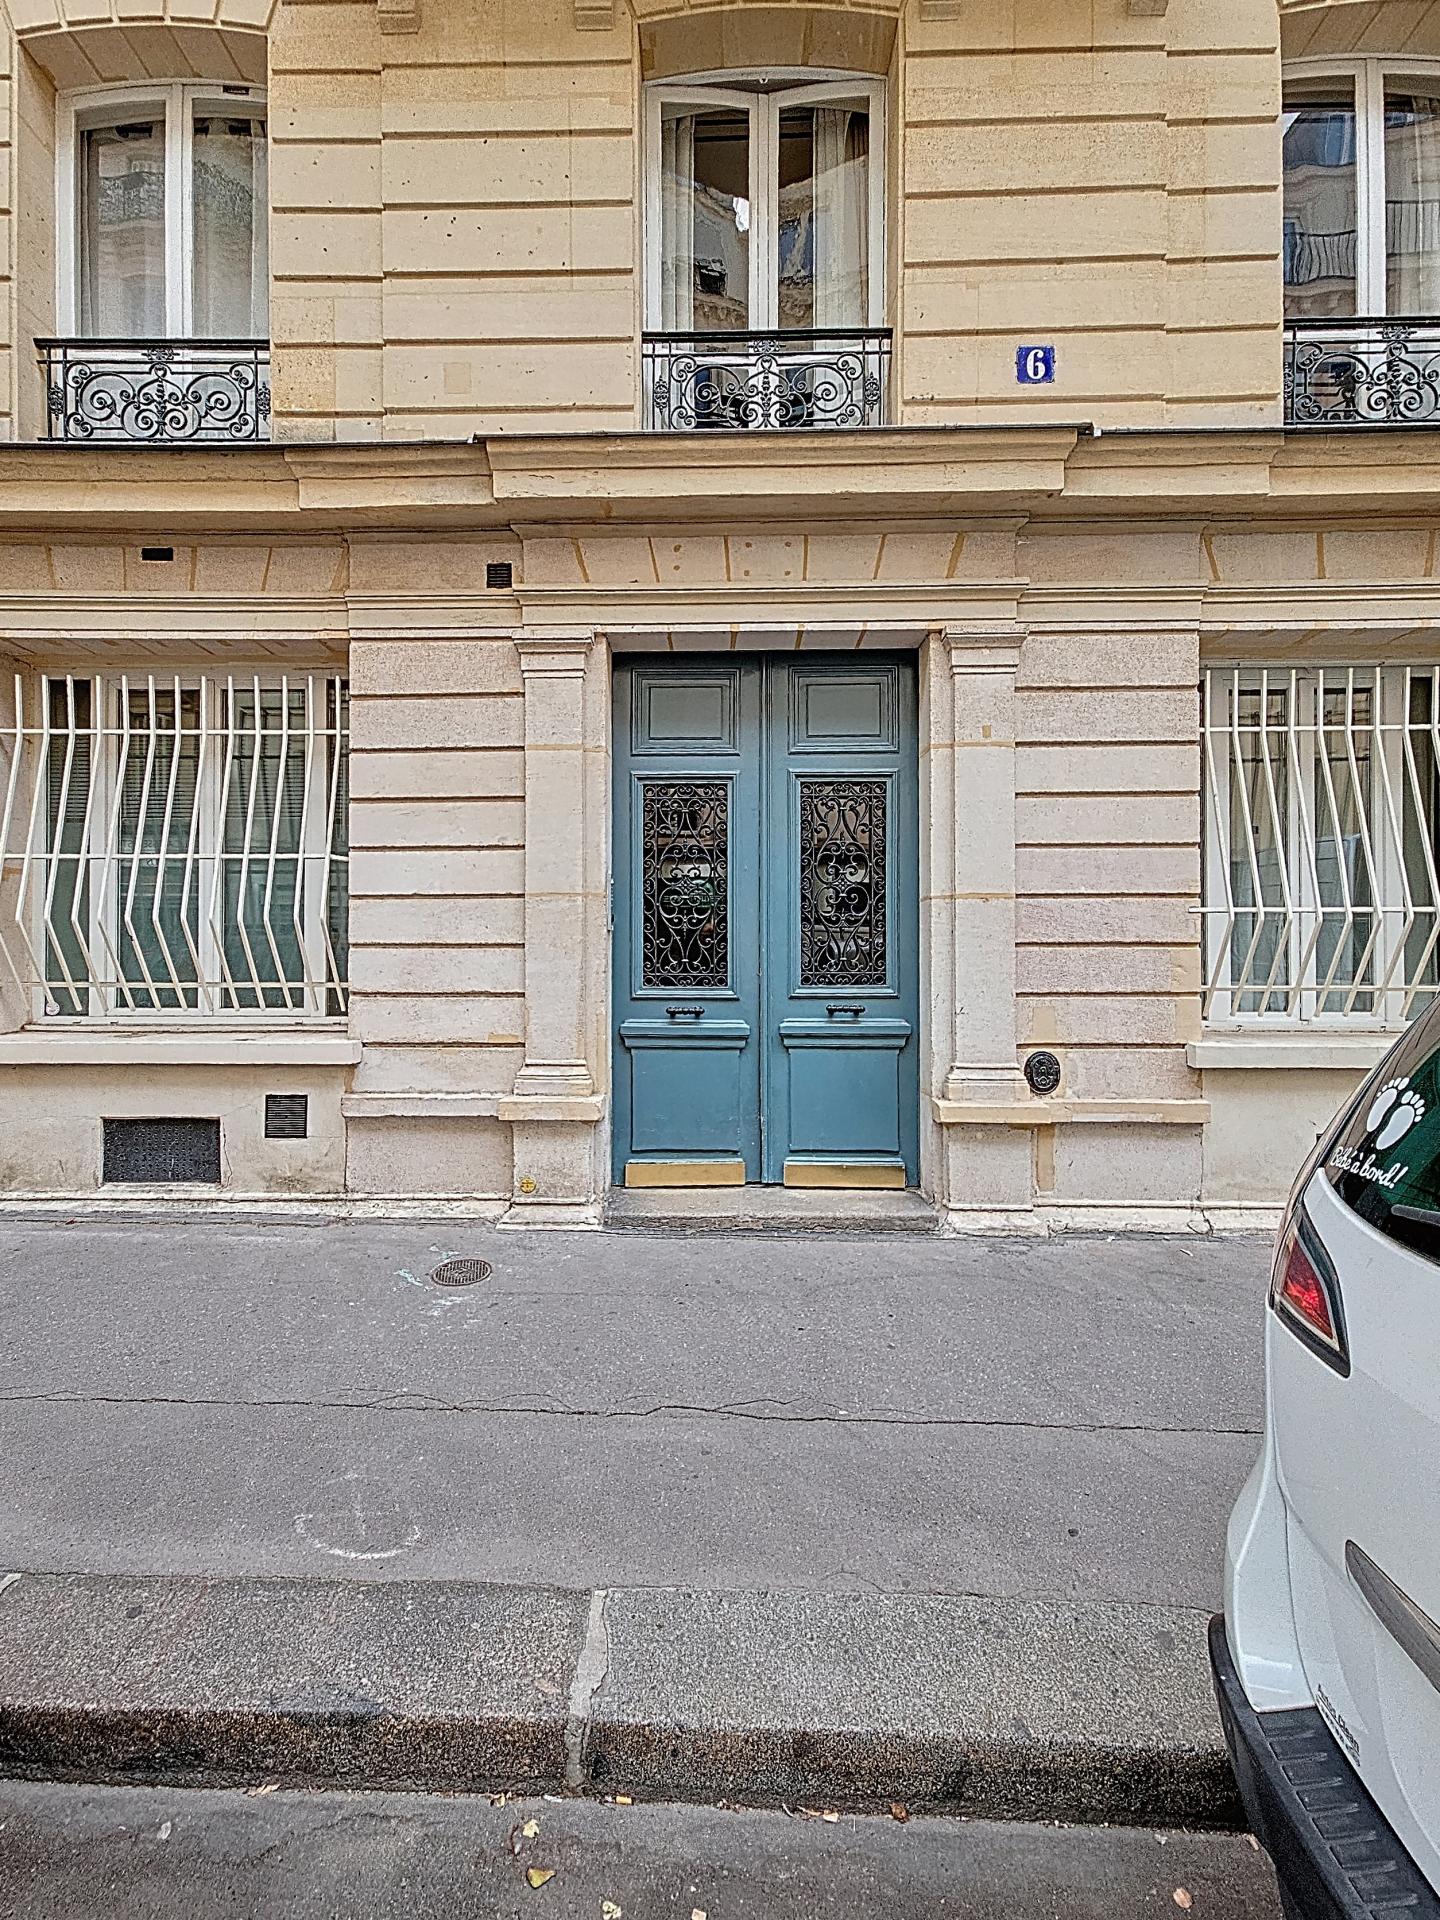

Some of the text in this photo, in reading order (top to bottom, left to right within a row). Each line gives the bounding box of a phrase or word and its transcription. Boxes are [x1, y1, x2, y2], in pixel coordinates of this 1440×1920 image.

[1026, 349, 1046, 380] 6
[1330, 1146, 1409, 1189] Bébé à bord!
